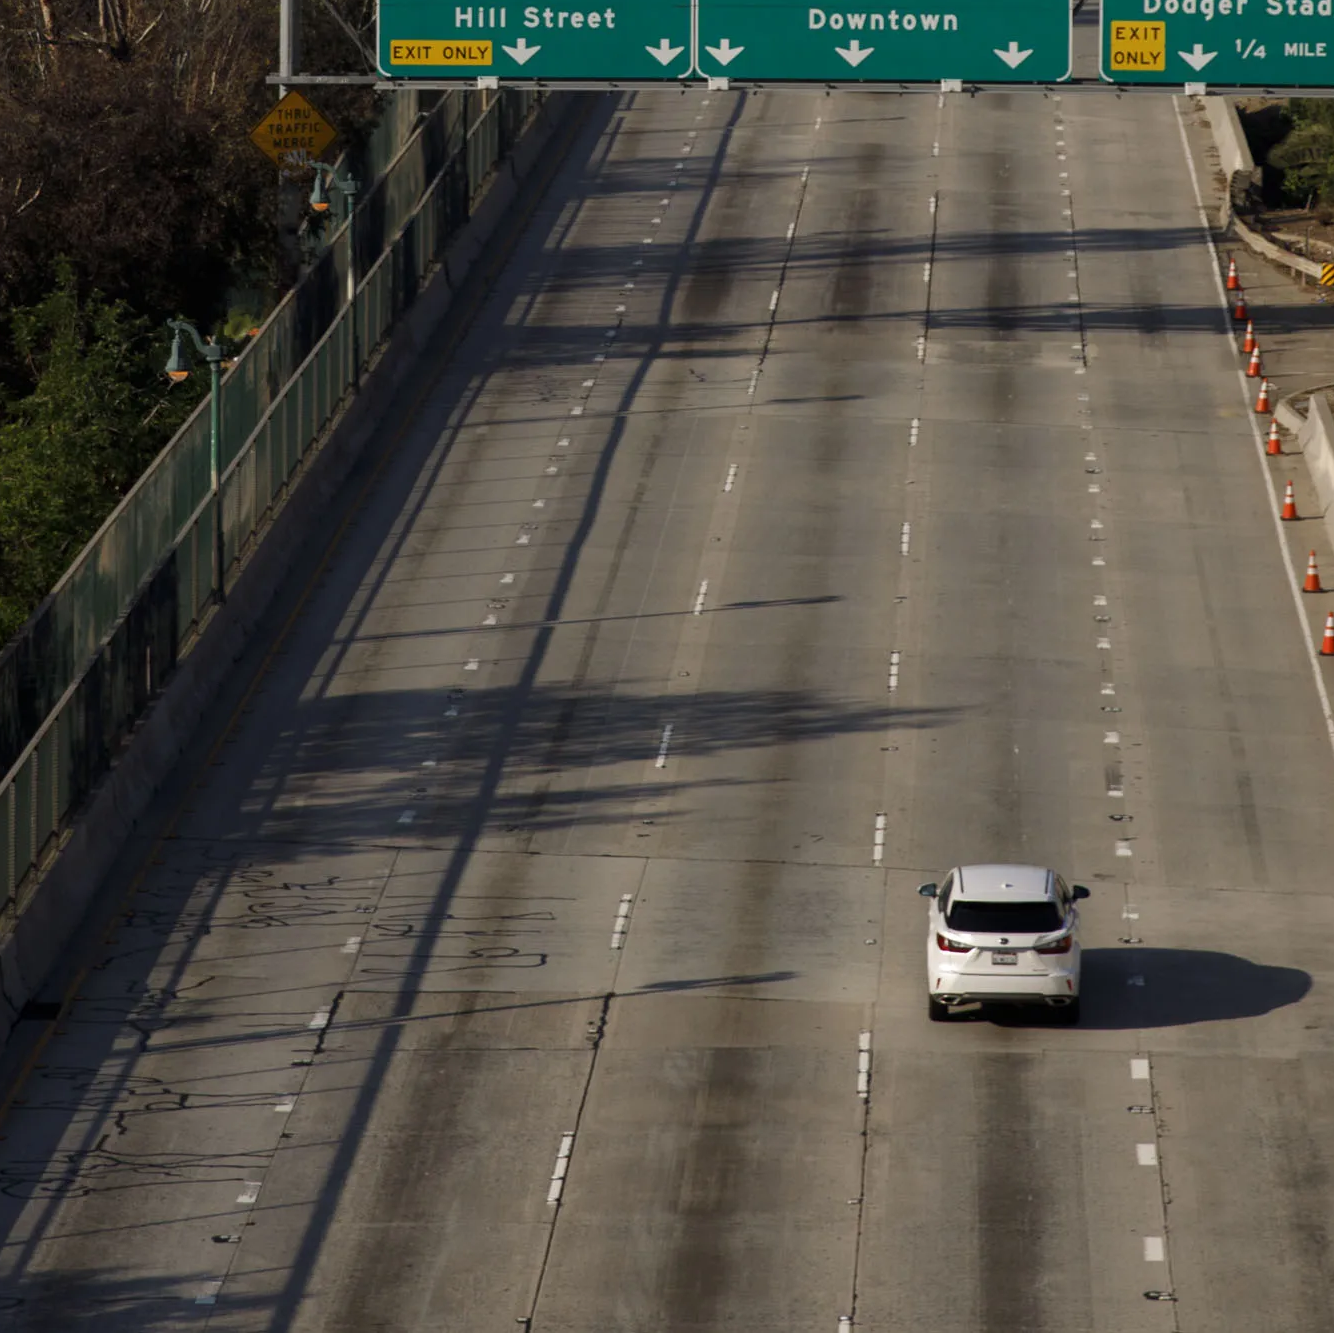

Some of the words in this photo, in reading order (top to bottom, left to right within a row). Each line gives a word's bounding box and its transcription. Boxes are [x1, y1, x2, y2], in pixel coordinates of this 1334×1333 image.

[455, 7, 506, 28] Hill
[523, 7, 616, 29] Street
[808, 8, 958, 31] Downtown
[1116, 26, 1161, 40] EXIT
[393, 46, 432, 59] EXIT
[443, 46, 489, 60] ONLY
[1284, 42, 1327, 57] MILE
[1114, 51, 1161, 65] ONLY
[277, 108, 312, 121] THRU
[269, 122, 320, 135] TRAFFIC
[273, 137, 315, 149] MERGE
